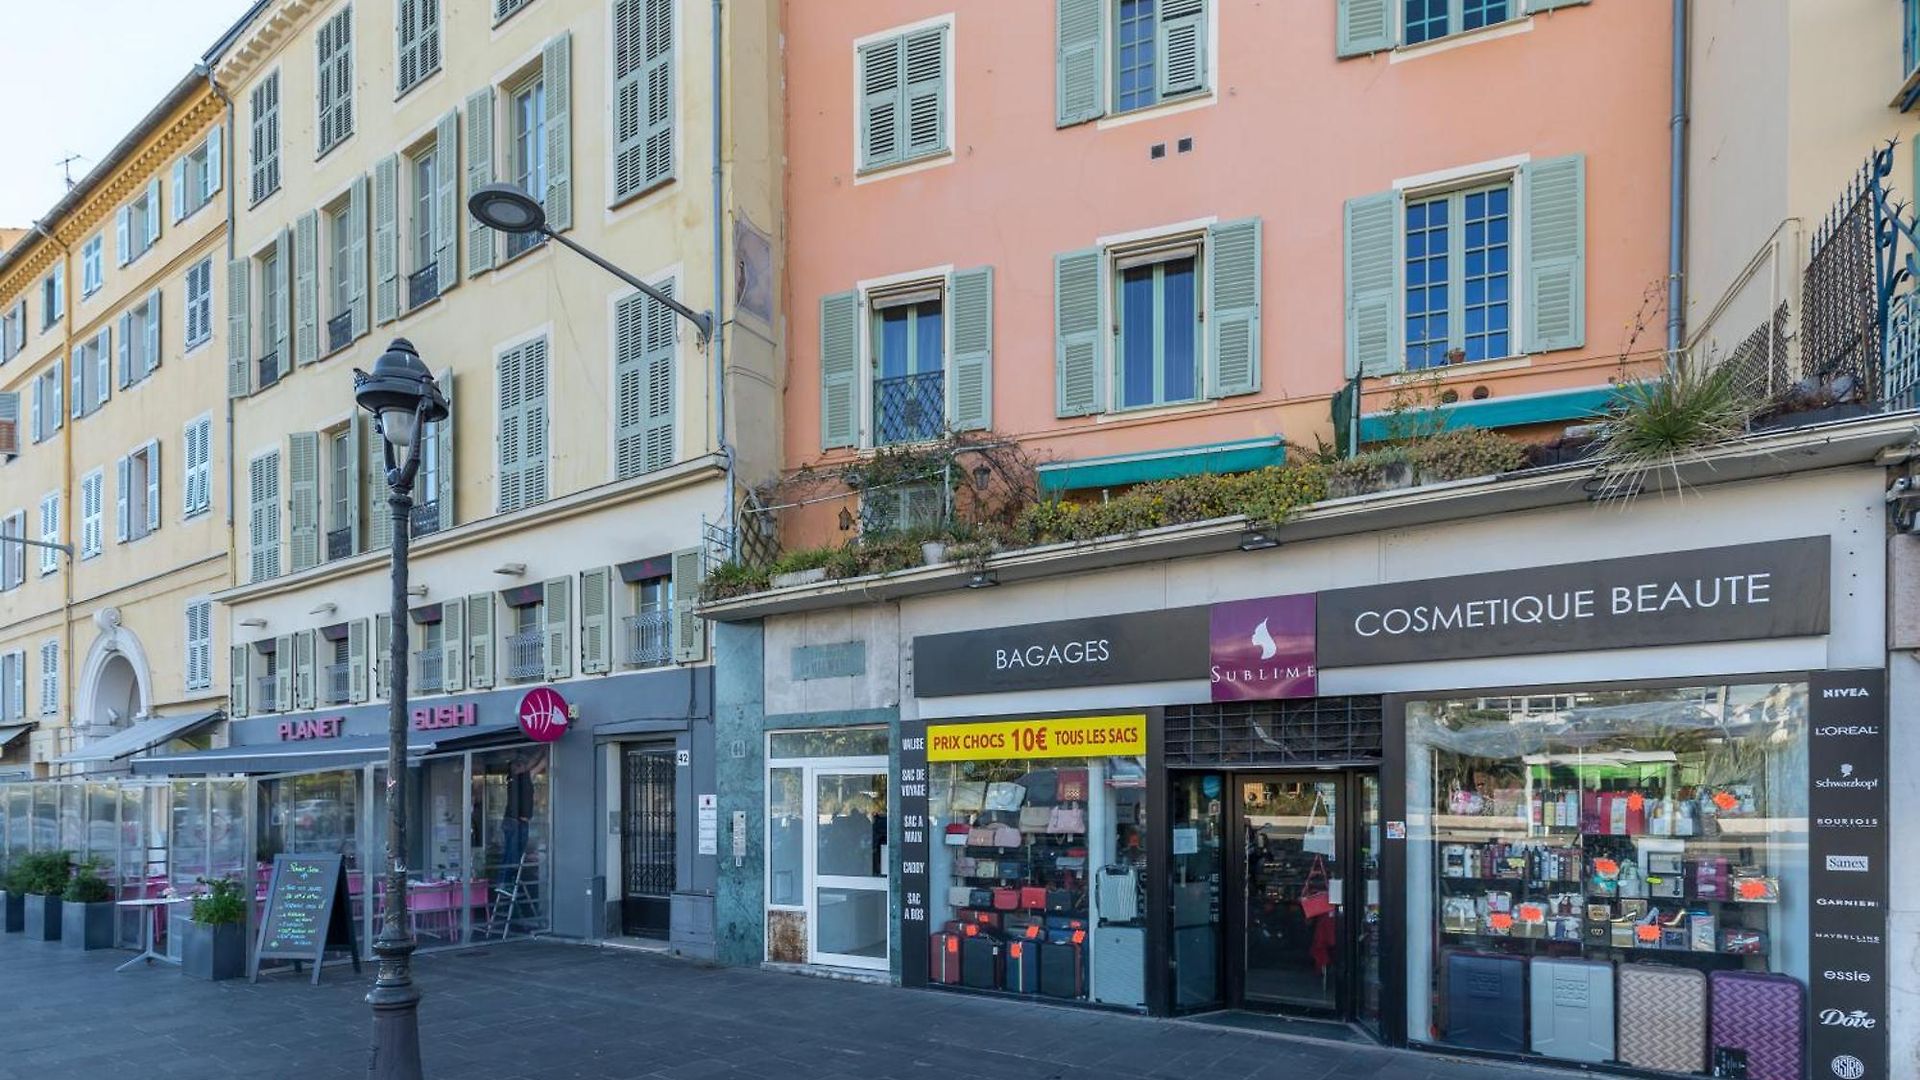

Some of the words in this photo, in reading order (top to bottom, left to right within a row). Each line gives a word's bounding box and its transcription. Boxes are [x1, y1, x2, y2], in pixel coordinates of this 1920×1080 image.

[1354, 590, 1595, 637] COSMETIQUE
[1611, 573, 1771, 615] BEAUTE
[995, 639, 1110, 669] BAGAGES
[1211, 665, 1316, 683] SUBLIME
[1823, 687, 1869, 698] NIVEA
[277, 717, 344, 741] PLANET
[411, 703, 478, 731] SUSHI
[933, 735, 960, 750] PRIX
[963, 734, 1005, 749] CHOCS
[1011, 727, 1048, 751] 10€
[1055, 729, 1084, 746] TOUS
[1086, 728, 1106, 745] LES
[1109, 727, 1138, 743] SACS
[678, 753, 688, 763] 42
[901, 768, 915, 782] SAC
[916, 768, 925, 781] DE
[1816, 777, 1878, 790] Schwarzkopf
[904, 815, 917, 828] SAC
[904, 831, 922, 843] MAIN
[1829, 857, 1866, 869] Sanex
[907, 892, 921, 905] SAC
[1816, 898, 1875, 908] GARNIER
[911, 908, 924, 921] DOS
[1815, 932, 1880, 941] MAYBELLINE
[1823, 970, 1871, 983] essie
[1819, 1008, 1876, 1029] Dove
